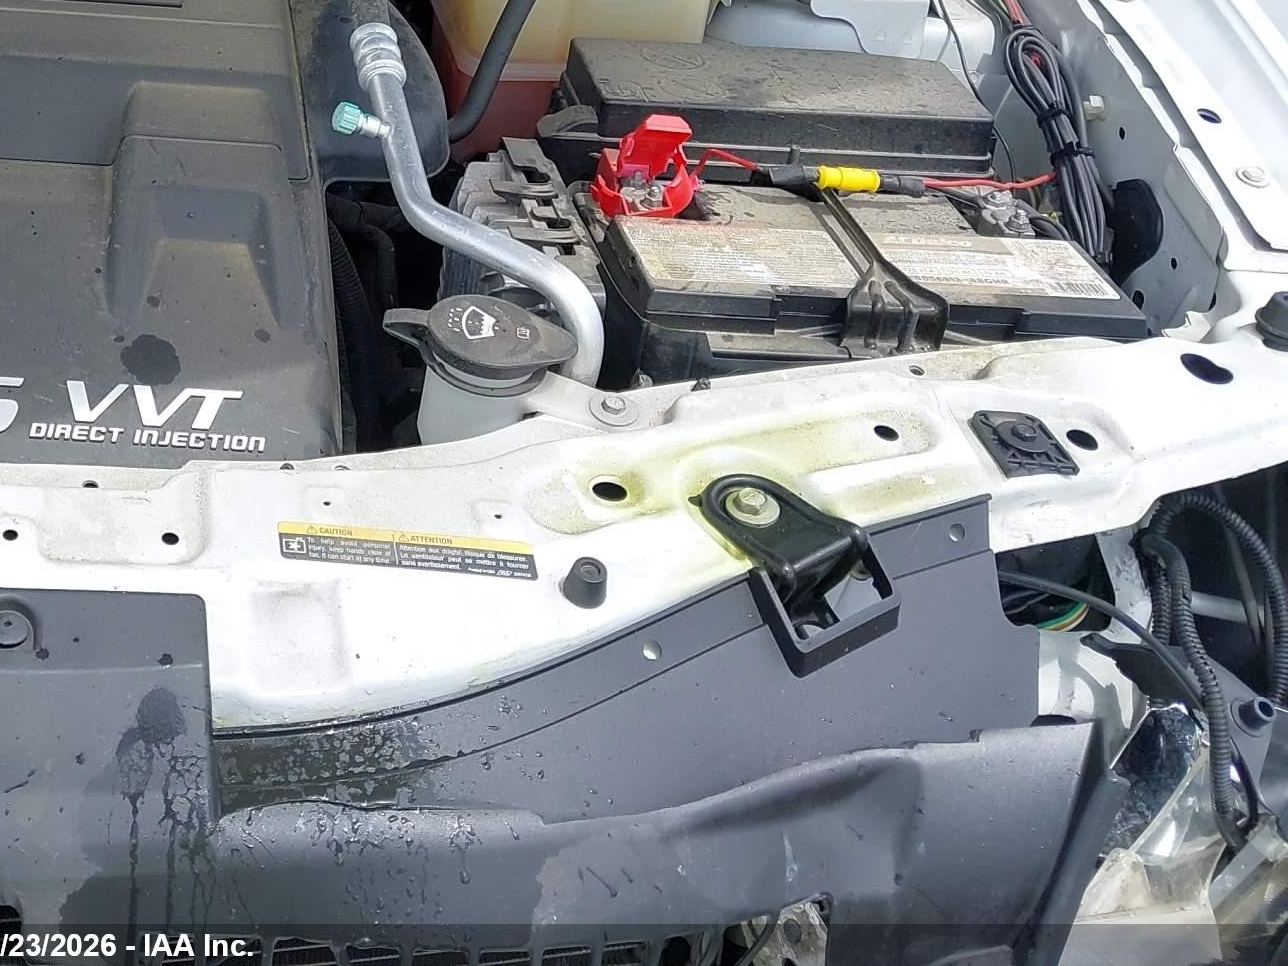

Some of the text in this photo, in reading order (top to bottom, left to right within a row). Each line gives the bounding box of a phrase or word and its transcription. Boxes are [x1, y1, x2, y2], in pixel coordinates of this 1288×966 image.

[66, 379, 243, 430] VVT
[29, 422, 266, 454] DIRECT INJECTION
[320, 527, 353, 536] CAUTION
[411, 535, 453, 545] ATTENTION
